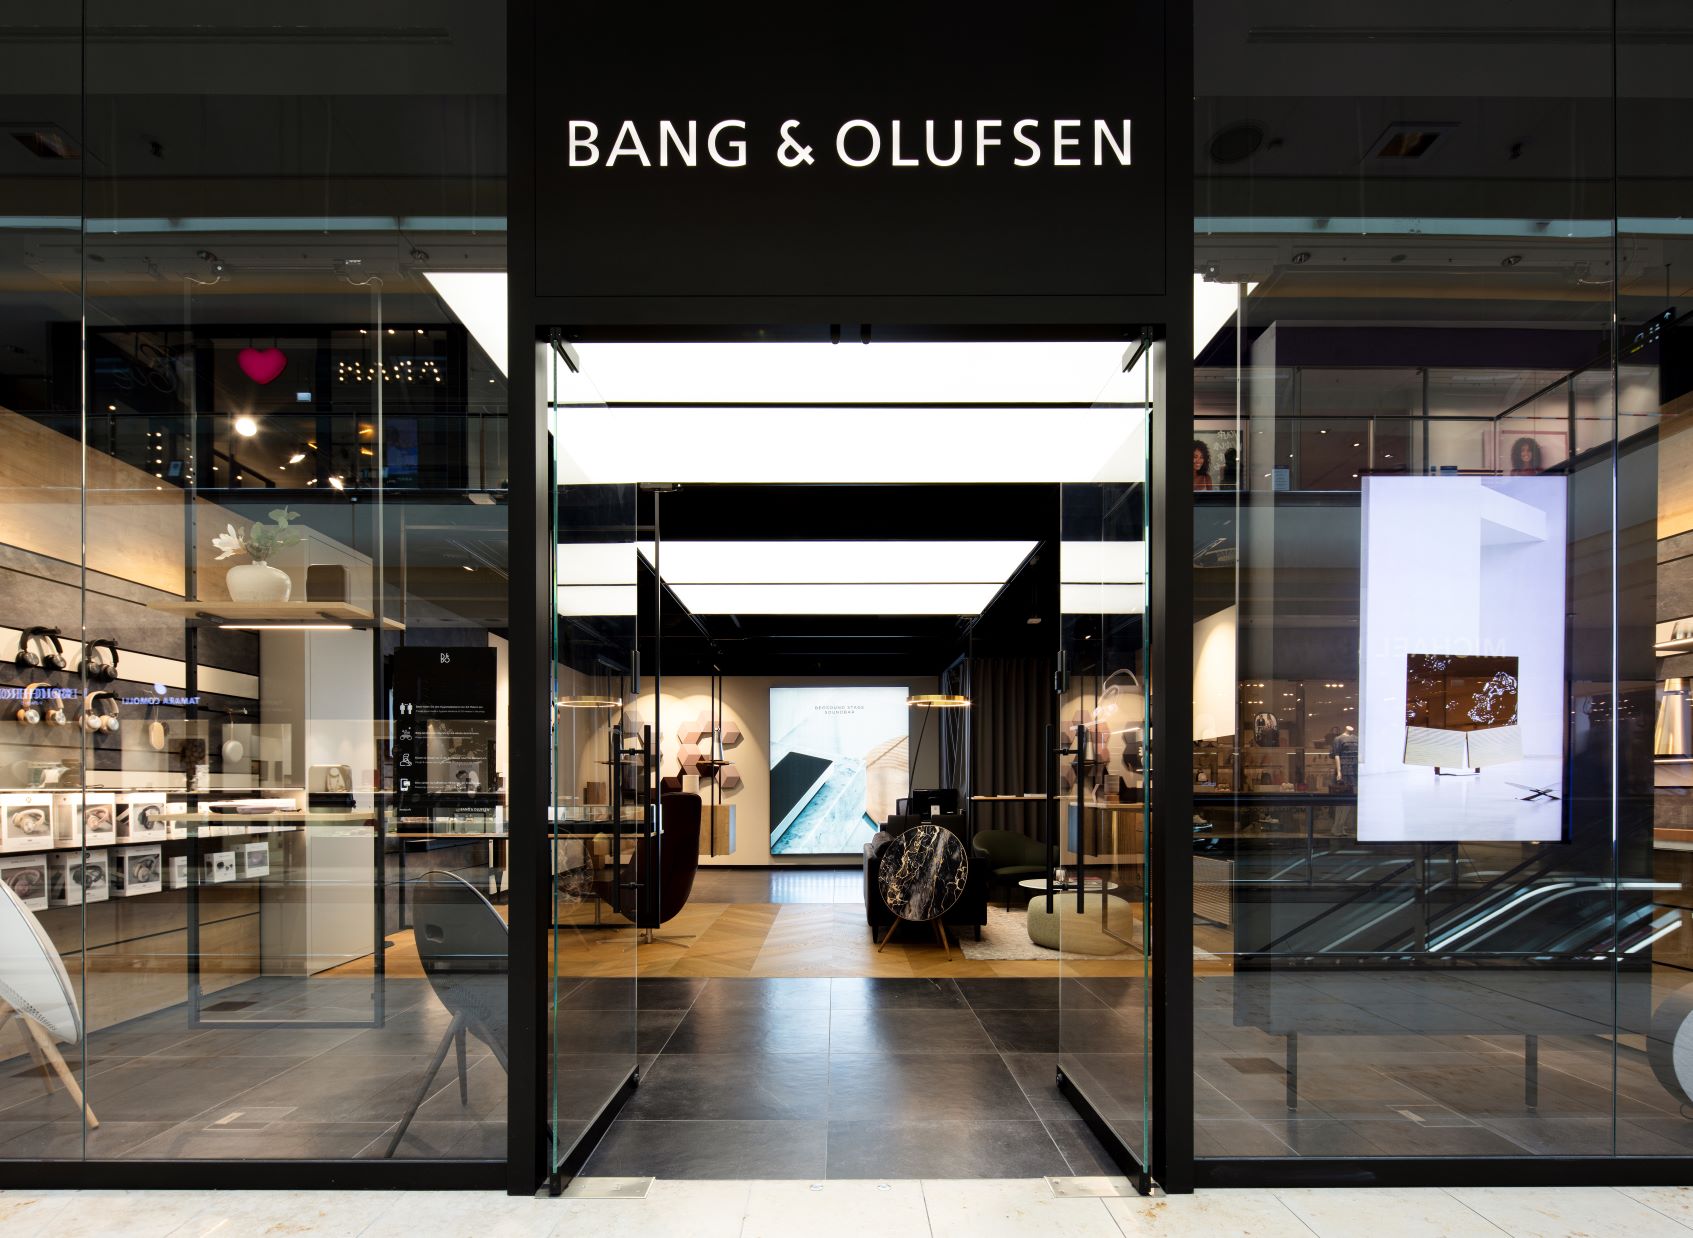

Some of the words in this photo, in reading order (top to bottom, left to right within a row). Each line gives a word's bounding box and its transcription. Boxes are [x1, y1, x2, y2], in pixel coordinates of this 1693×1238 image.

[568, 119, 748, 167] BANG
[776, 119, 815, 167] &
[835, 119, 1132, 166] OLUFSEN
